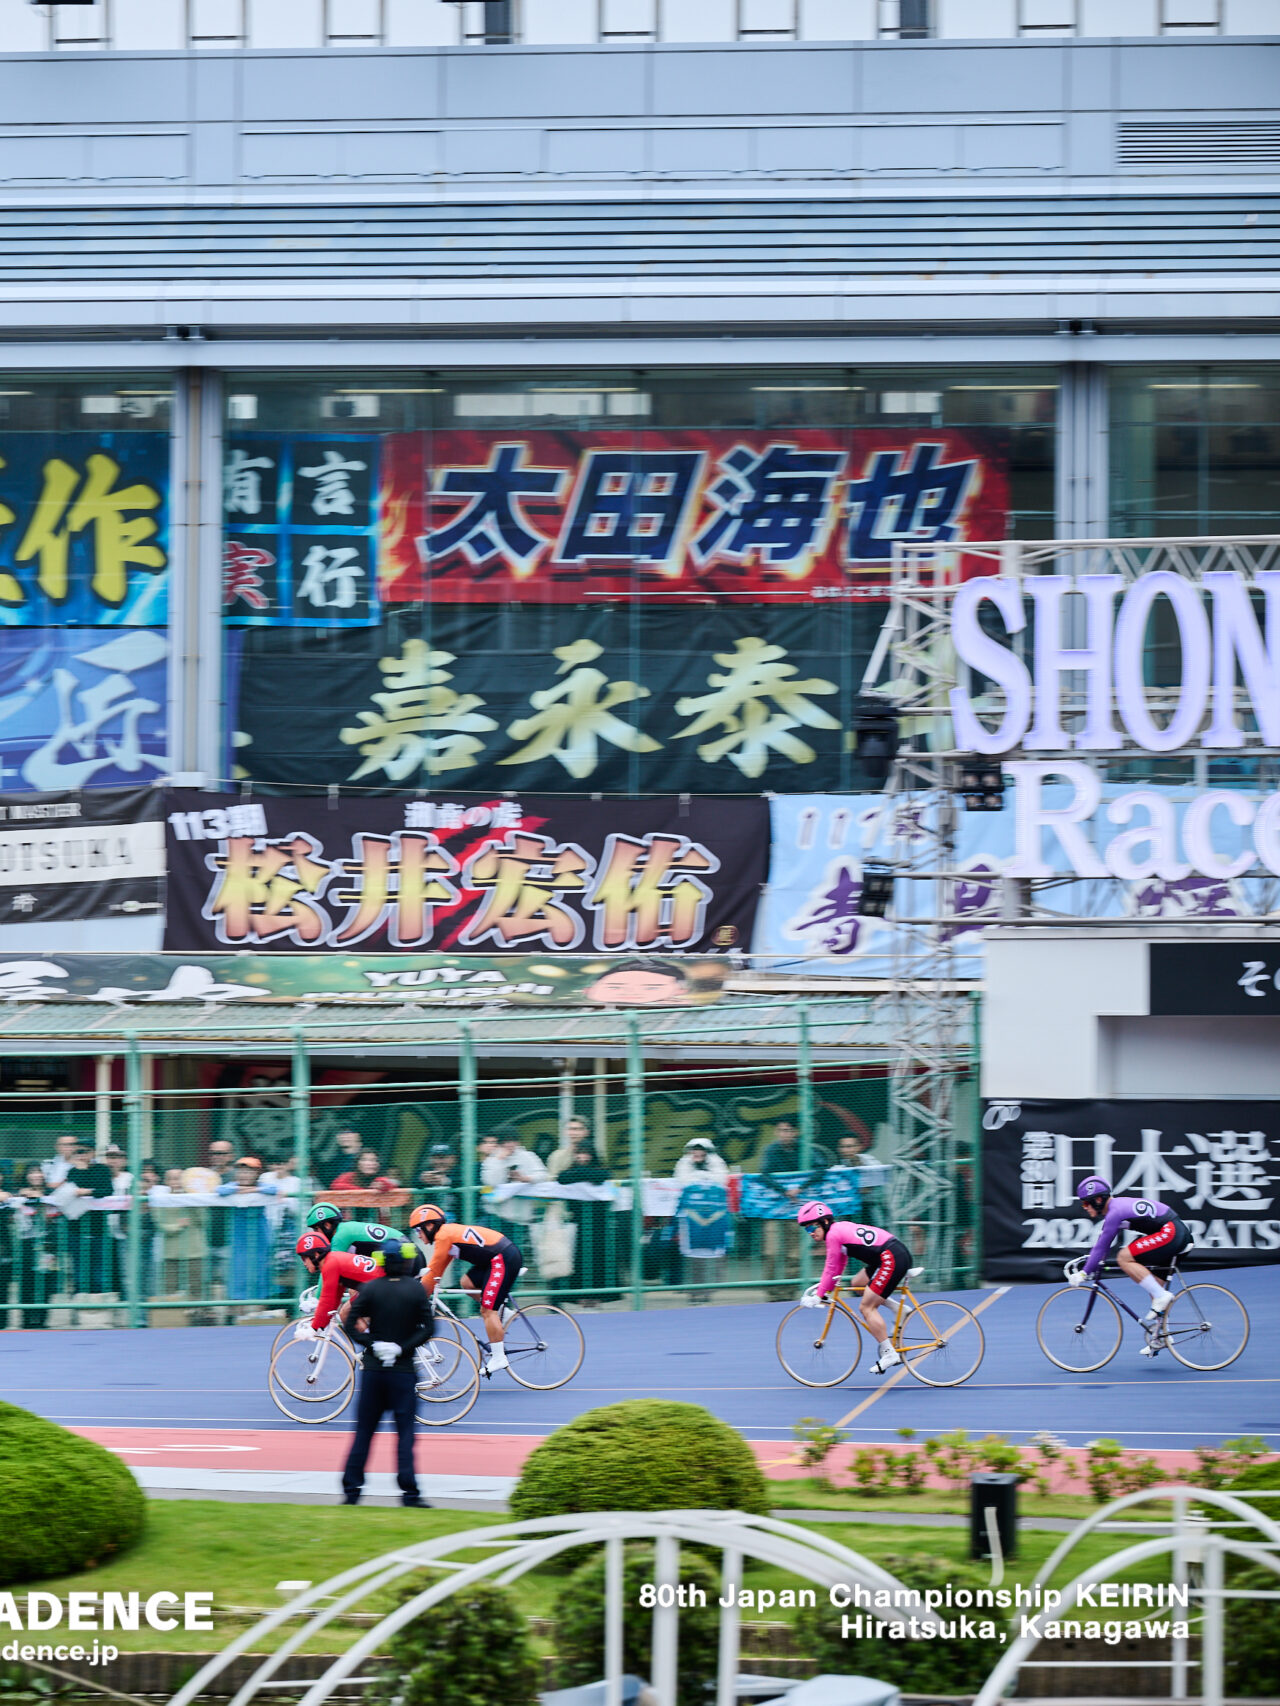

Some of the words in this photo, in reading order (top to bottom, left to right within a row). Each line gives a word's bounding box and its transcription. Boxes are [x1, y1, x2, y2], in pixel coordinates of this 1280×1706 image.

[417, 438, 982, 572] 太田海也
[950, 570, 1280, 755] SHON
[168, 803, 268, 841] 113期
[201, 830, 721, 952] 松井宏佑
[363, 966, 508, 988] YUYA
[1052, 1128, 1280, 1211] 日本選
[1085, 1182, 1096, 1195] 9
[1131, 1199, 1157, 1219] 9
[303, 1235, 315, 1250] 3
[365, 1222, 389, 1242] 6
[462, 1225, 486, 1248] 7
[855, 1227, 876, 1246] 8
[353, 1253, 377, 1273] 3
